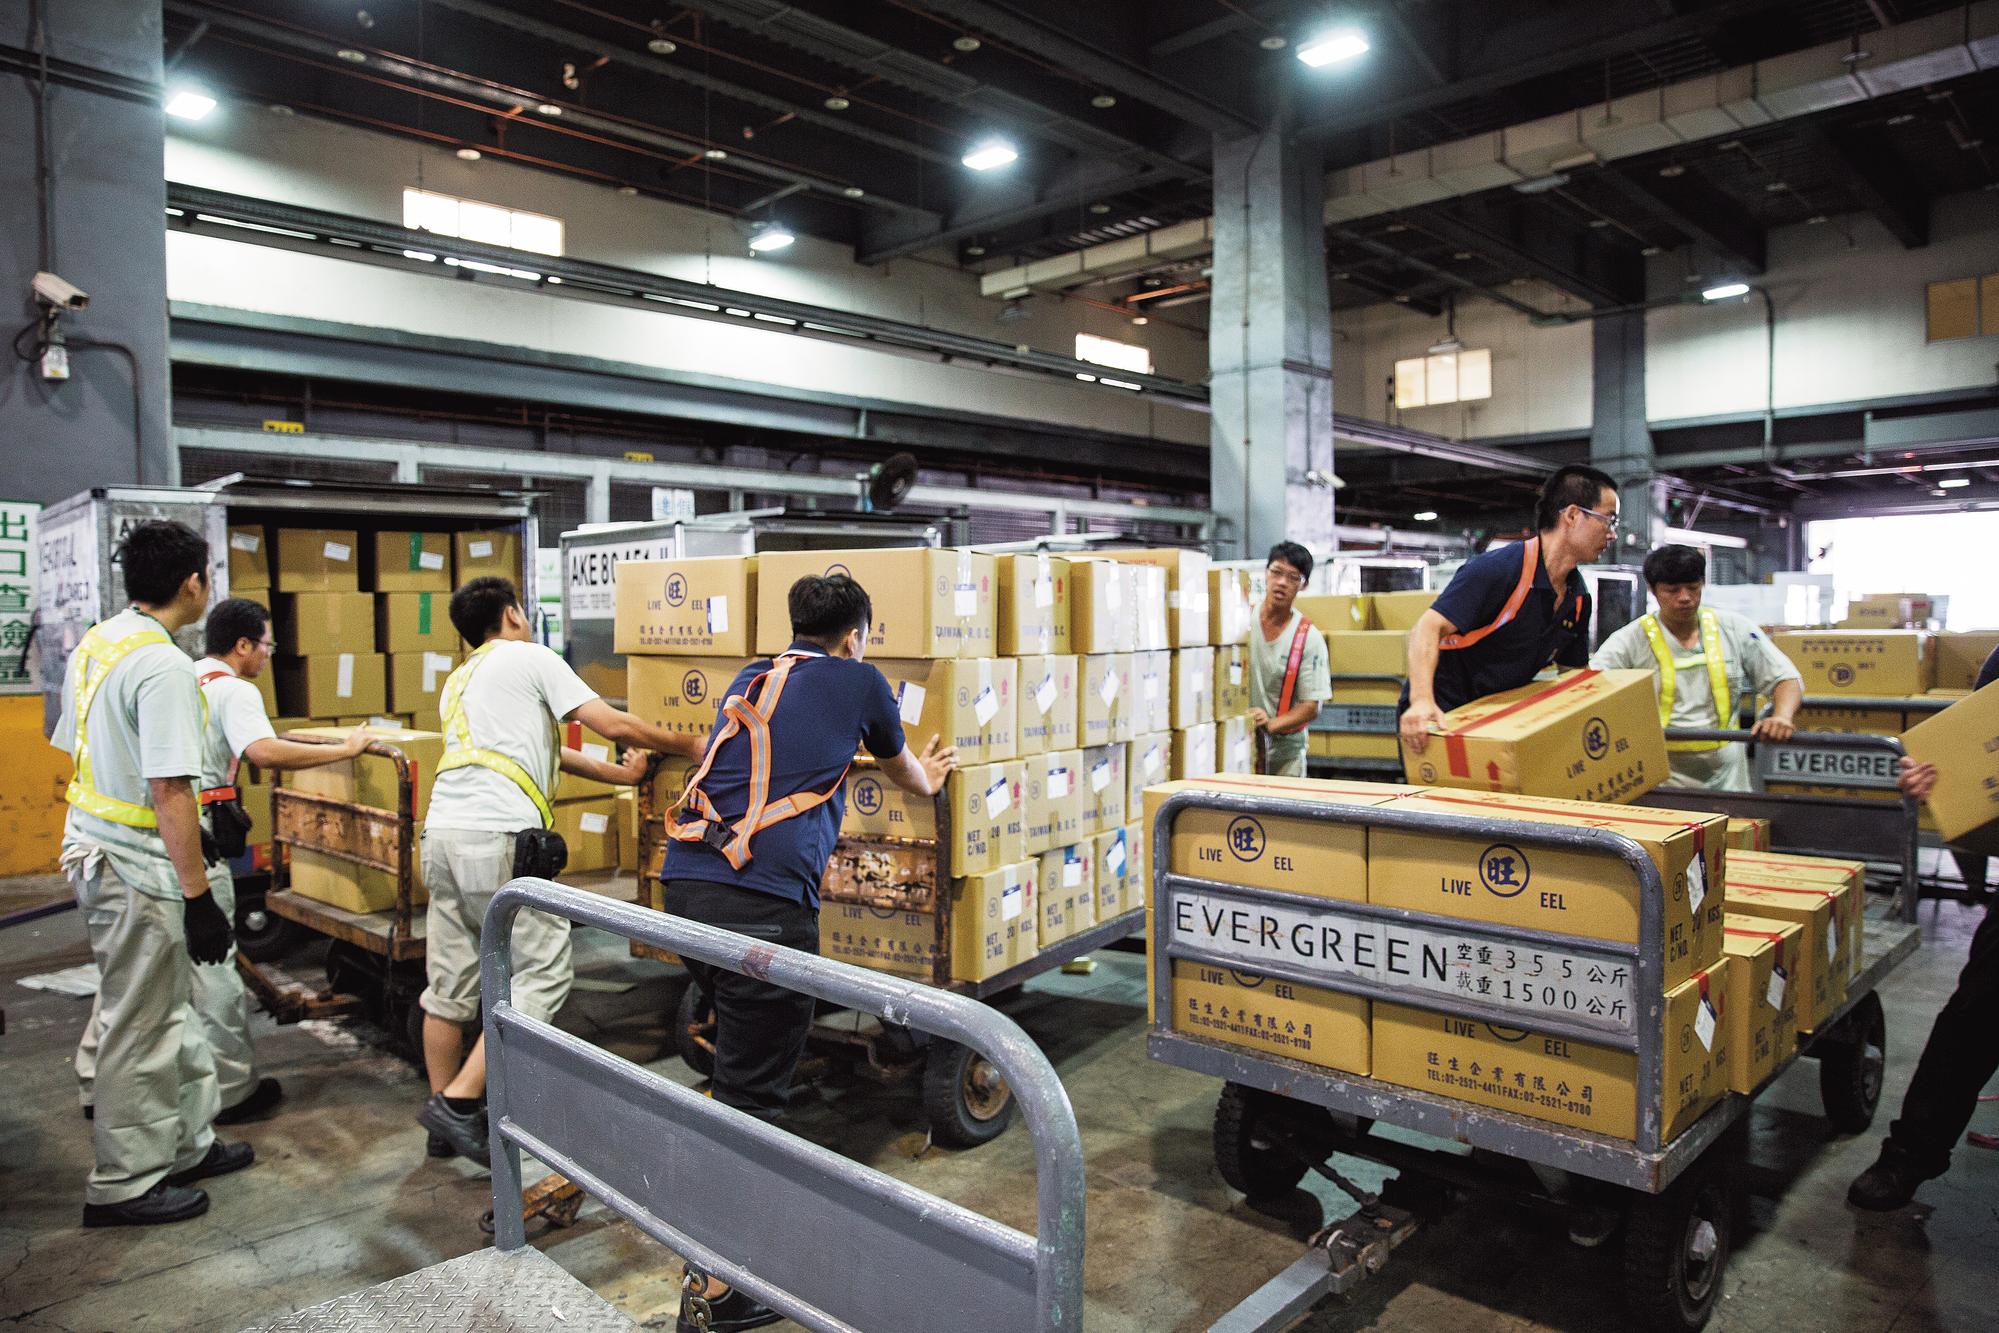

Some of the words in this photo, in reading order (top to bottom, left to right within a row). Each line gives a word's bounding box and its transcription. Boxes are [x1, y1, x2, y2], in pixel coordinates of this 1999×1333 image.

[647, 600, 661, 610] LIVE
[692, 600, 703, 610] EEL
[664, 697, 679, 707] LIVE
[1778, 751, 1901, 778] EVERGREE
[889, 810, 904, 822] EEL
[967, 829, 981, 842] NET
[1198, 846, 1222, 862] LIVE
[1274, 856, 1294, 872] EEL
[1441, 877, 1472, 897] LIVE
[1540, 892, 1567, 911] EEL
[842, 905, 863, 919] LIVE
[905, 914, 922, 927] EEL
[986, 932, 999, 946] NET
[1175, 899, 1448, 983] EVERGREEN
[1670, 922, 1684, 945] NET
[1200, 968, 1224, 985] LIVE
[1275, 983, 1296, 1000] EEL
[1443, 1018, 1476, 1039] LIVE
[1543, 1039, 1571, 1058] EEL
[1427, 1051, 1593, 1103] 旺生企業有限公司
